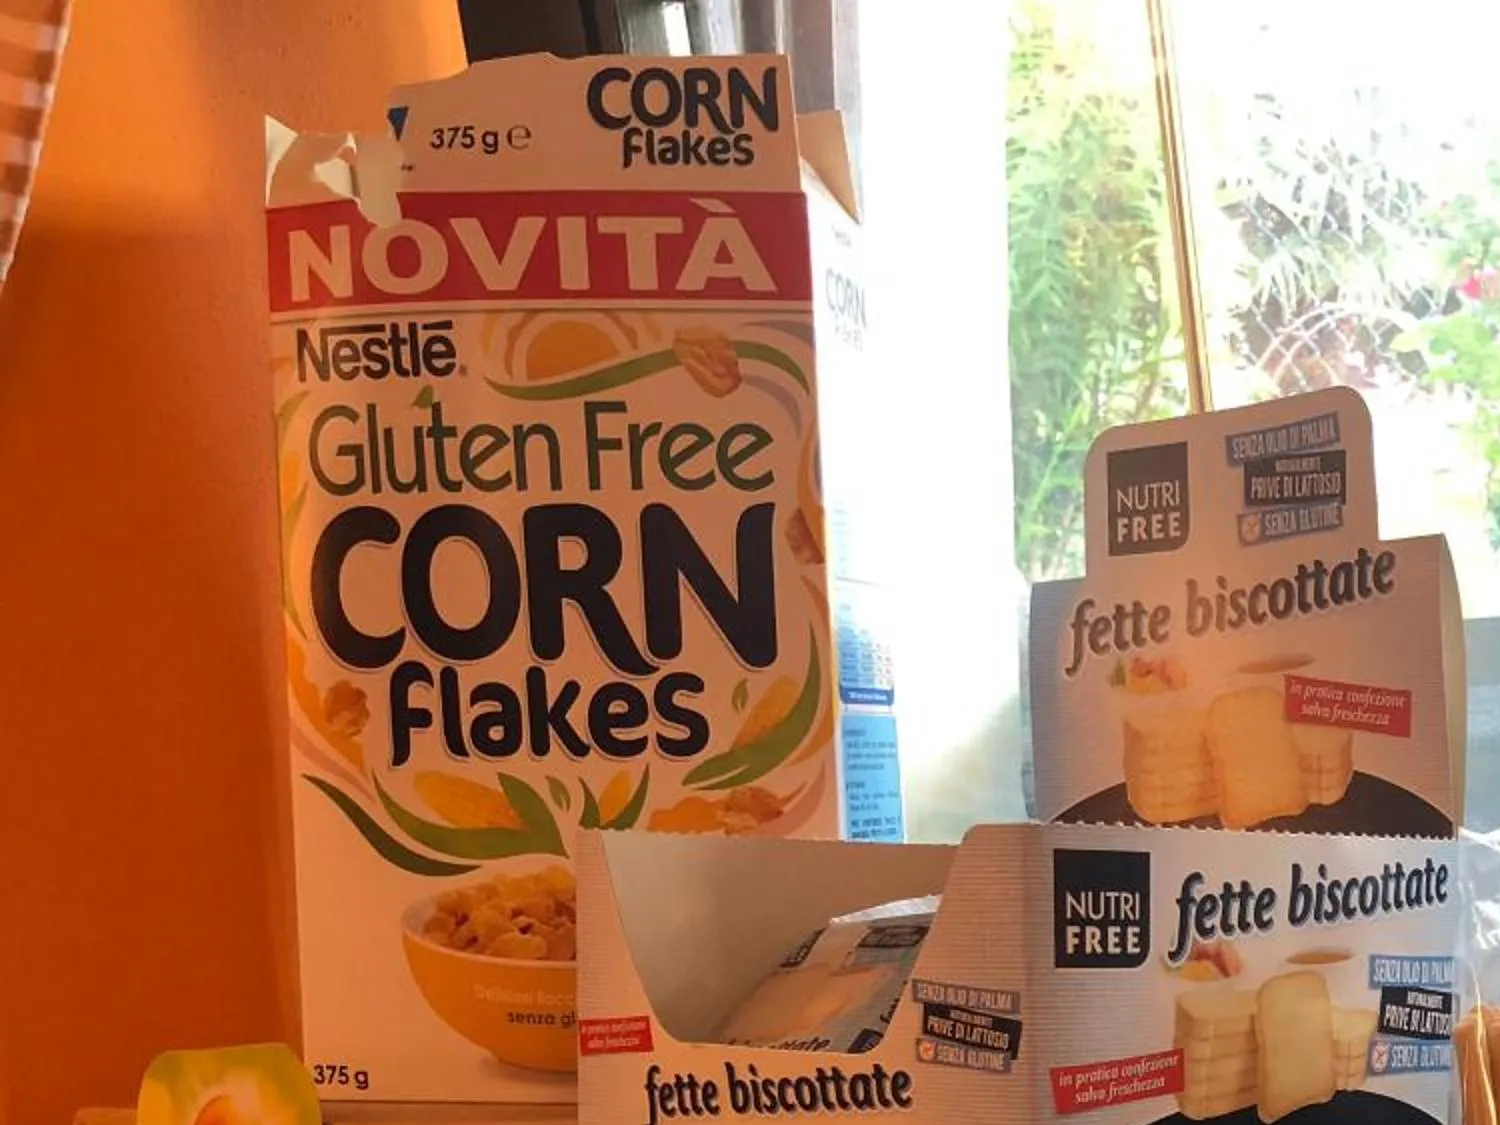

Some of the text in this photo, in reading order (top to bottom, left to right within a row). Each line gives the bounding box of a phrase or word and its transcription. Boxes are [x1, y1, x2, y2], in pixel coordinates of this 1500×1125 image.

[586, 66, 779, 135] CORN
[430, 125, 475, 150] 375
[481, 129, 499, 154] g
[622, 127, 754, 168] flakes
[289, 198, 777, 303] NOVITÀ
[296, 320, 457, 383] Nestlé
[309, 400, 776, 496] Gluten Free
[1232, 434, 1265, 459] SENZA
[1302, 416, 1336, 446] PALMA
[1116, 480, 1181, 514] NUTRI
[1252, 472, 1341, 499] PRIVE DI LATTOSIO
[1117, 511, 1183, 544] FREE
[1265, 503, 1340, 535] SENZA GLUTINE
[310, 502, 779, 676] CORN
[1065, 547, 1396, 676] fette biscottate
[391, 660, 709, 768] flakes
[1066, 891, 1141, 920] NUTRI
[1167, 858, 1449, 963] fette biscottate
[1066, 925, 1142, 955] FREE
[1373, 959, 1400, 983] SENZA
[916, 983, 945, 1004] SENZA
[980, 990, 1013, 1010] PALMA
[507, 1011, 556, 1025] senza
[927, 1015, 955, 1037] PRIVE
[955, 1020, 965, 1039] DI
[965, 1024, 1009, 1050] LATTOSIO
[1383, 1003, 1410, 1031] PRIVE
[936, 1045, 1005, 1071] SENZA GLUTINE
[1391, 1044, 1418, 1068] SENZA
[313, 1064, 370, 1090] 375 g
[724, 1062, 912, 1117] biscottate
[1075, 1064, 1119, 1090] pratica
[1075, 1085, 1106, 1105] salva
